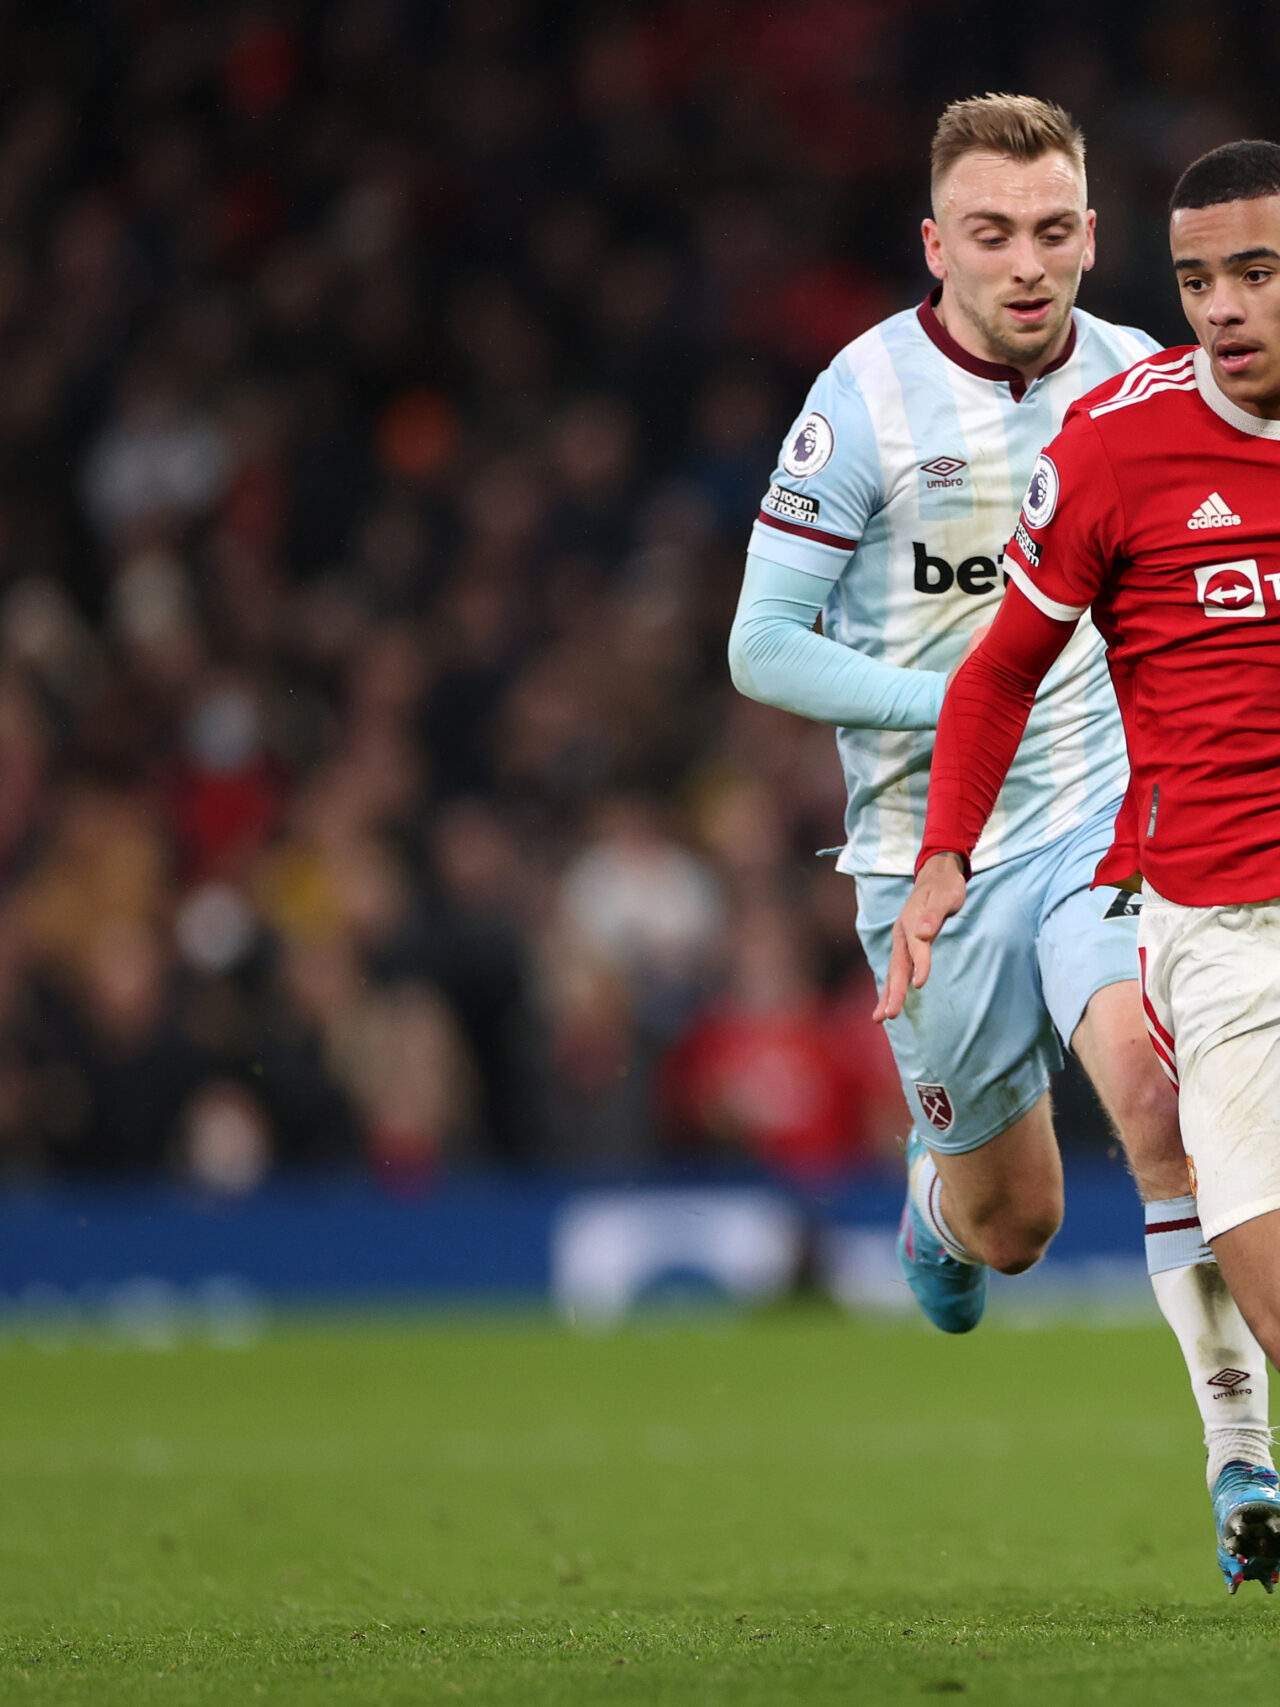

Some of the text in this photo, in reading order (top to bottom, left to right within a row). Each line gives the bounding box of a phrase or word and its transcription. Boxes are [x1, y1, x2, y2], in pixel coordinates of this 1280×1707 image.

[926, 477, 963, 489] umbro
[780, 492, 814, 512] room
[1186, 513, 1242, 530] adidas
[1212, 1387, 1253, 1400] umbro
